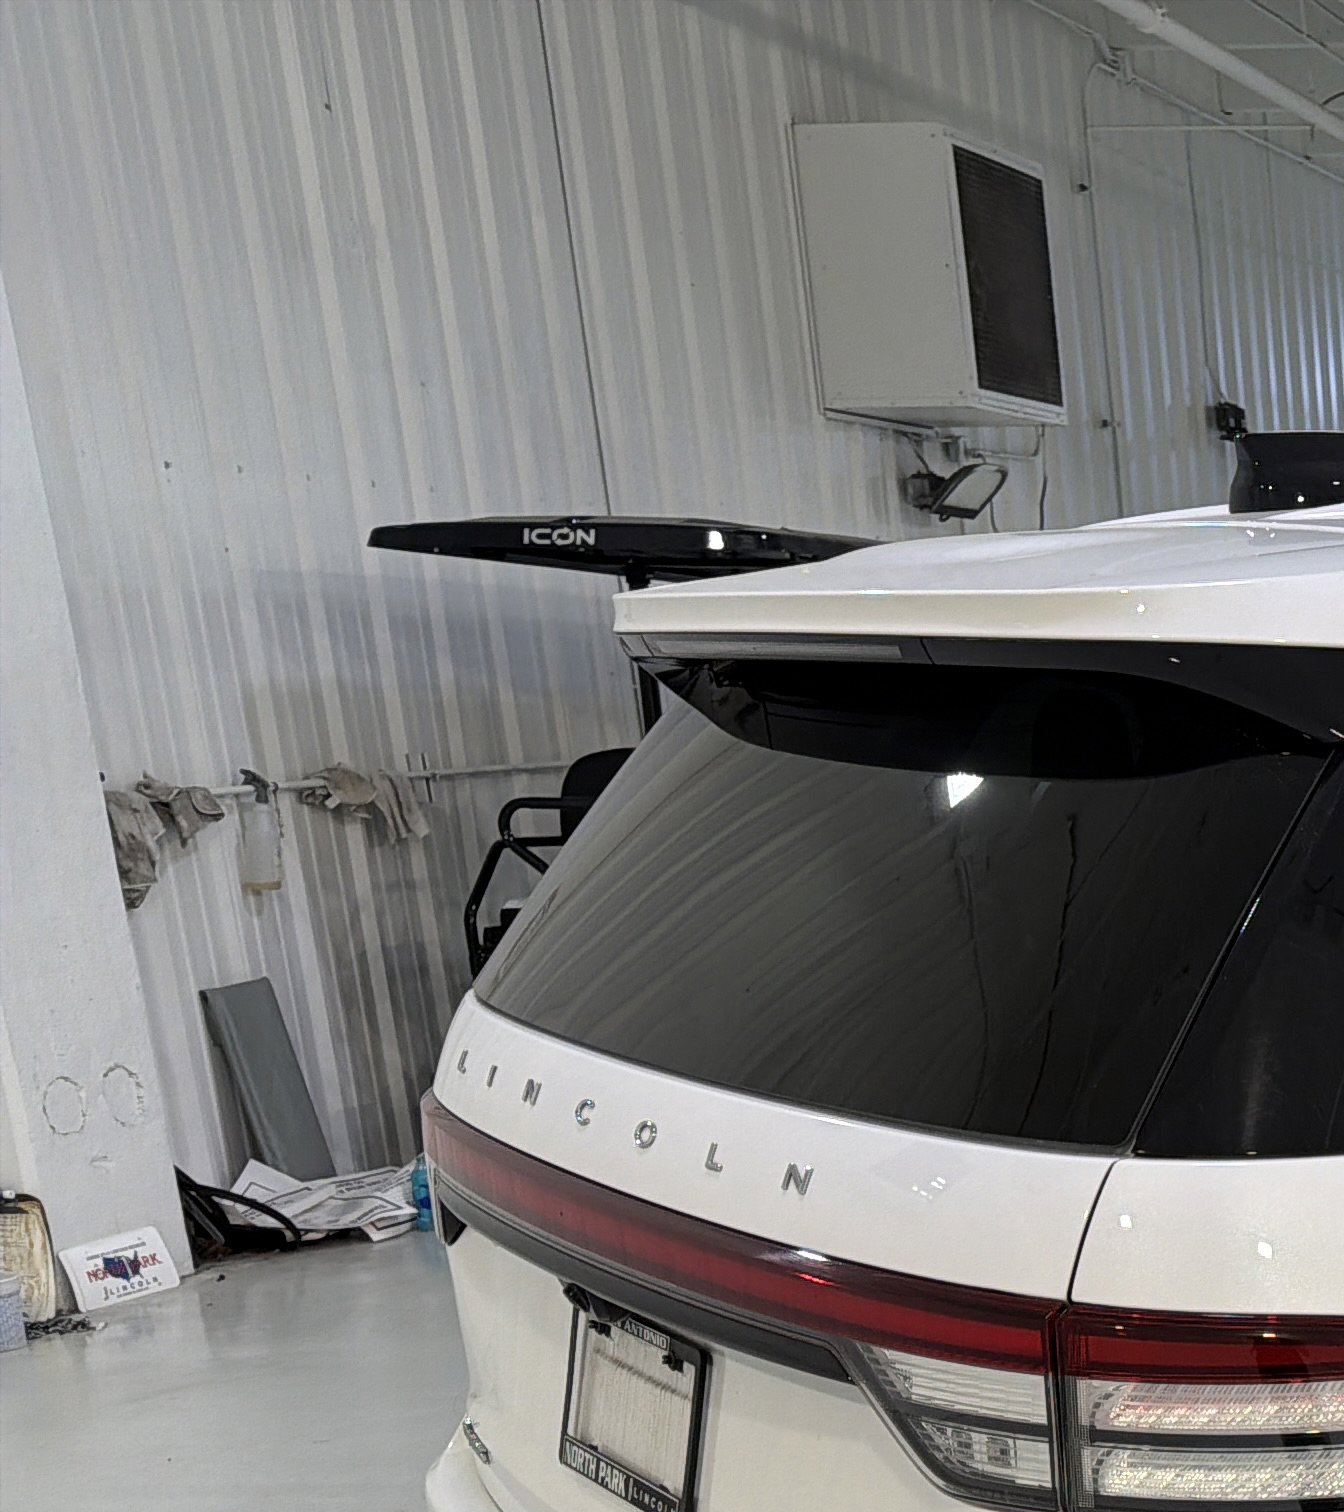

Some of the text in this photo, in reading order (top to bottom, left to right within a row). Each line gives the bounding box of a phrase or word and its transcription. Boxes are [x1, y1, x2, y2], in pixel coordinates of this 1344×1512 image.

[522, 526, 596, 546] ICON
[456, 1049, 814, 1196] LINCOLN
[109, 1276, 159, 1297] LINCOLN
[624, 1319, 668, 1350] ANTONIO
[564, 1440, 598, 1480] NORTH
[598, 1460, 627, 1498] PARK
